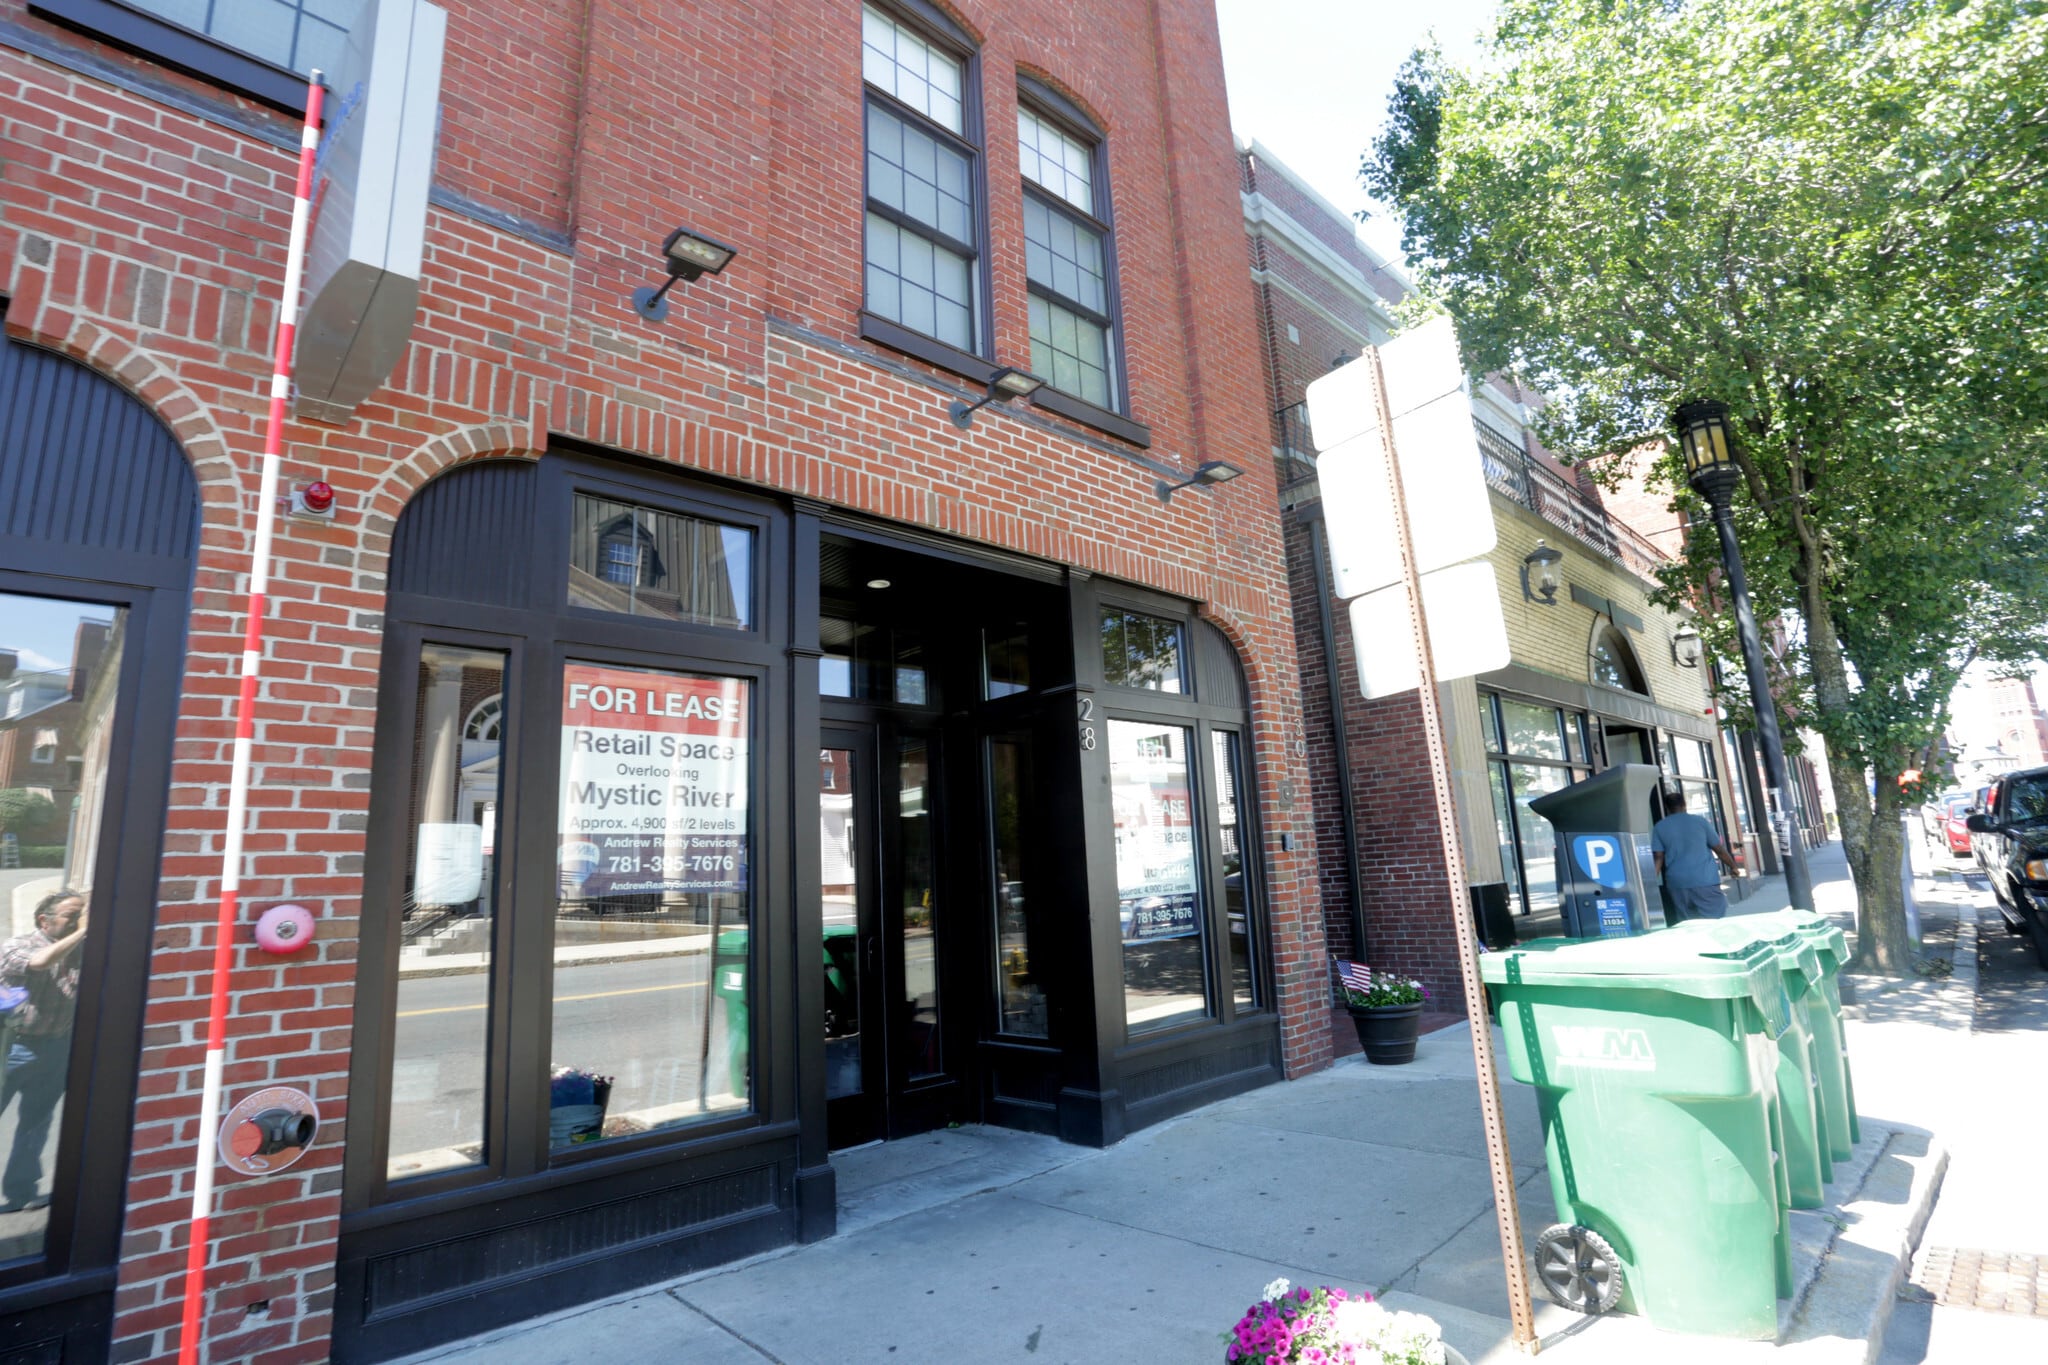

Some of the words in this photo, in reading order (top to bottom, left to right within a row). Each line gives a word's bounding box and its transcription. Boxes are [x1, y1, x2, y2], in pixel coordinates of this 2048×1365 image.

[568, 683, 637, 714] FOR
[646, 690, 739, 723] LEASE
[573, 729, 651, 756] Retail
[659, 736, 735, 763] Space
[570, 781, 662, 810] Mystic
[672, 784, 735, 808] River
[570, 816, 628, 831] Approx.
[631, 817, 667, 830] 4,900
[699, 818, 736, 830] levels
[603, 837, 650, 848] Andrew
[691, 837, 738, 848] Services
[608, 855, 734, 873] 781-395-7676
[1585, 840, 1613, 880] P
[1136, 906, 1193, 924] 781-395-7676
[1552, 1025, 1656, 1060] WM
